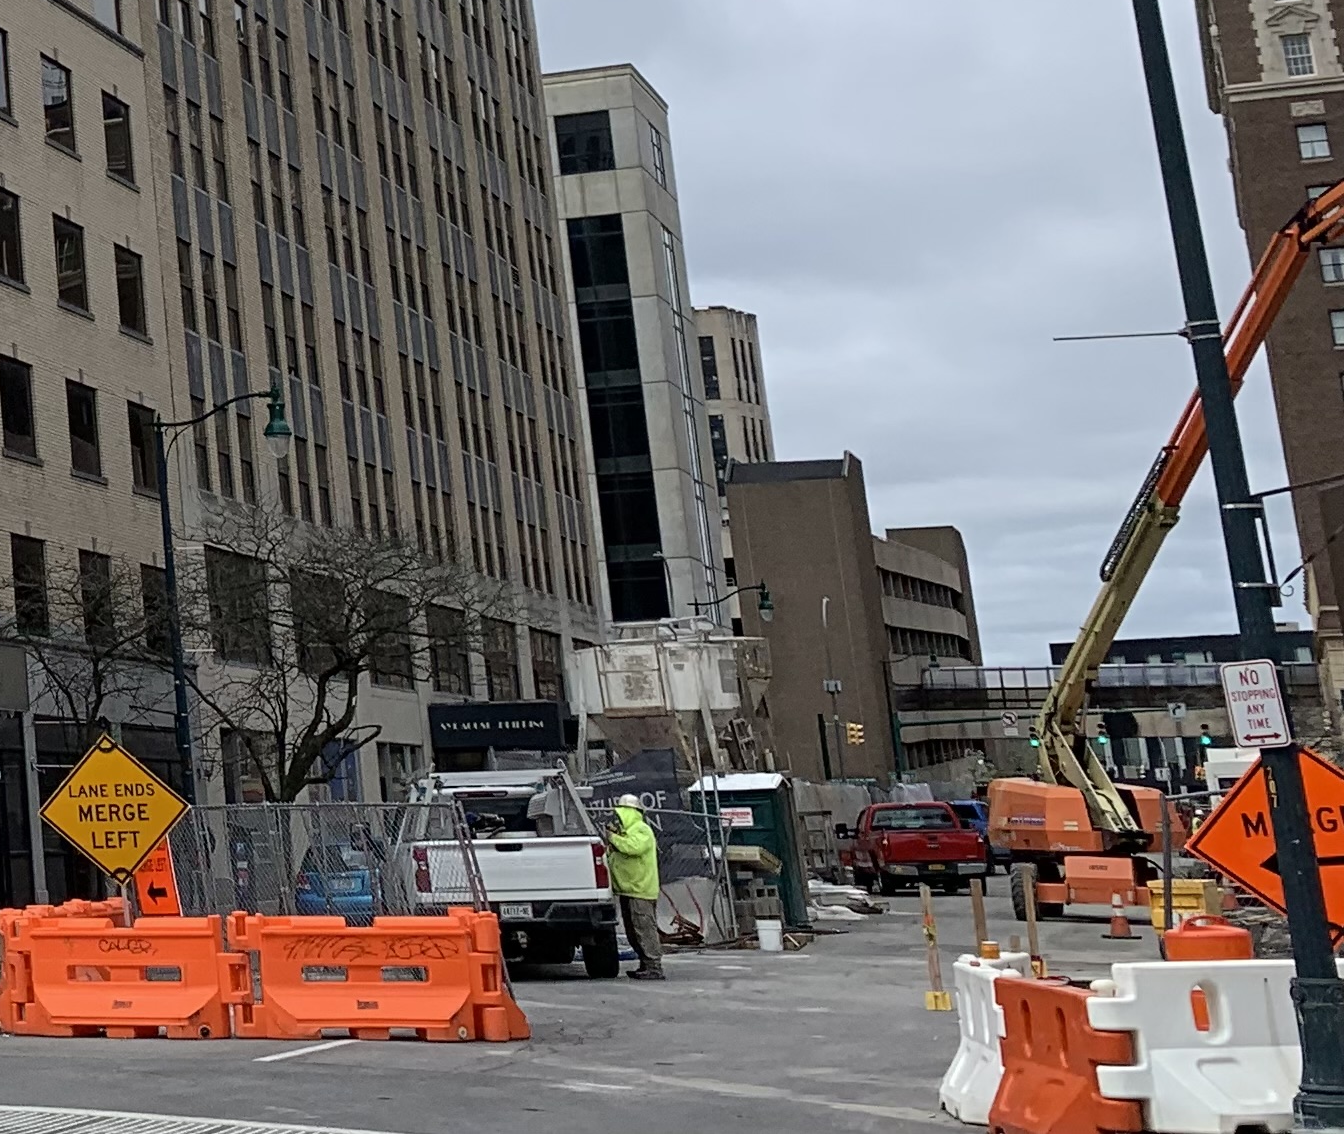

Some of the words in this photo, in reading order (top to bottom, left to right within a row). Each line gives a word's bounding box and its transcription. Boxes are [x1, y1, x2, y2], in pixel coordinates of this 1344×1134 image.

[1239, 669, 1259, 686] NO
[1231, 687, 1276, 703] STOPPING
[1247, 704, 1265, 715] ANY
[1247, 717, 1272, 730] TIME
[68, 784, 109, 798] LANE
[114, 783, 155, 797] ENDS
[639, 790, 667, 811] OF
[78, 803, 150, 822] MERGE
[91, 831, 140, 849] LEFT
